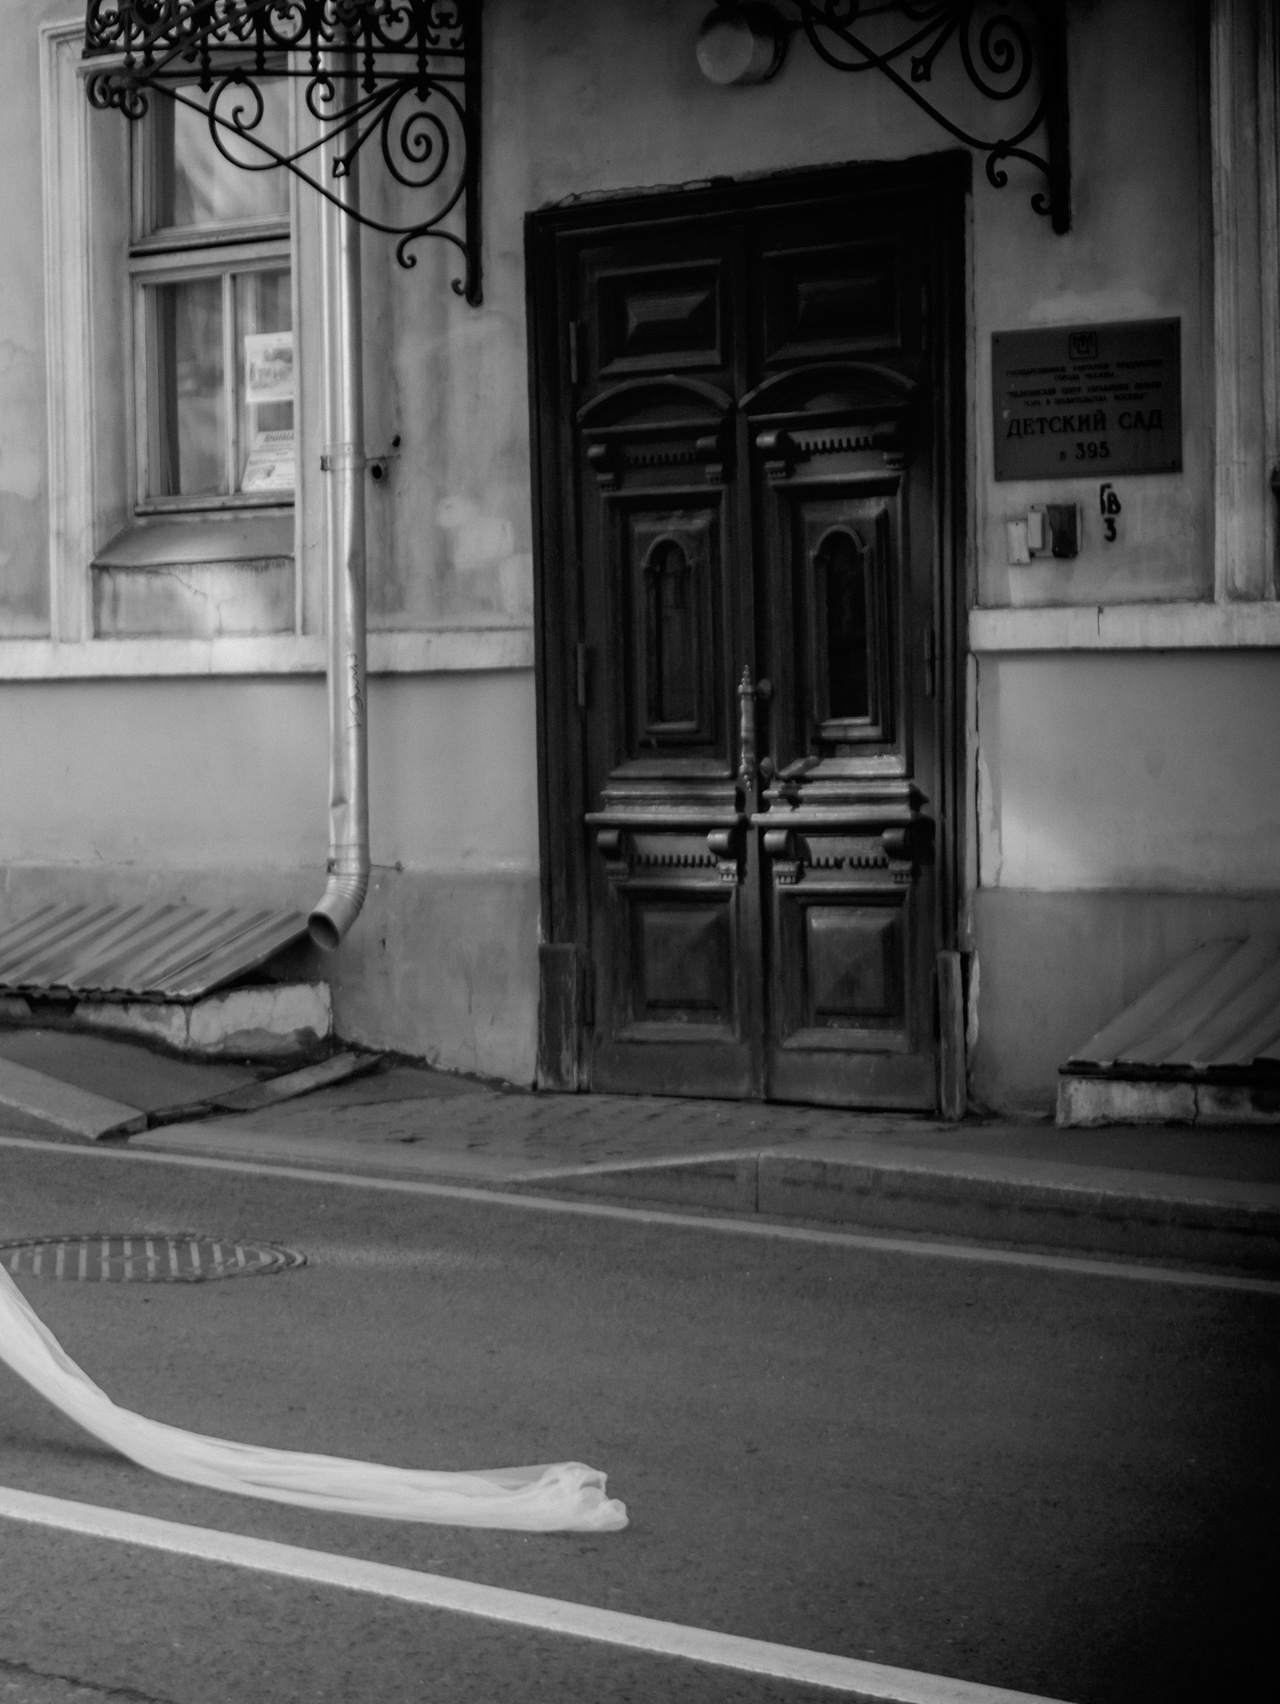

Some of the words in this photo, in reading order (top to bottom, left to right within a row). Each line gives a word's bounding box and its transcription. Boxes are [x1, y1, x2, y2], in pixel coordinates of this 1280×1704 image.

[1007, 409, 1107, 439] ДЕТСКИЙ
[1118, 409, 1164, 432] САД
[1075, 440, 1111, 460] 395
